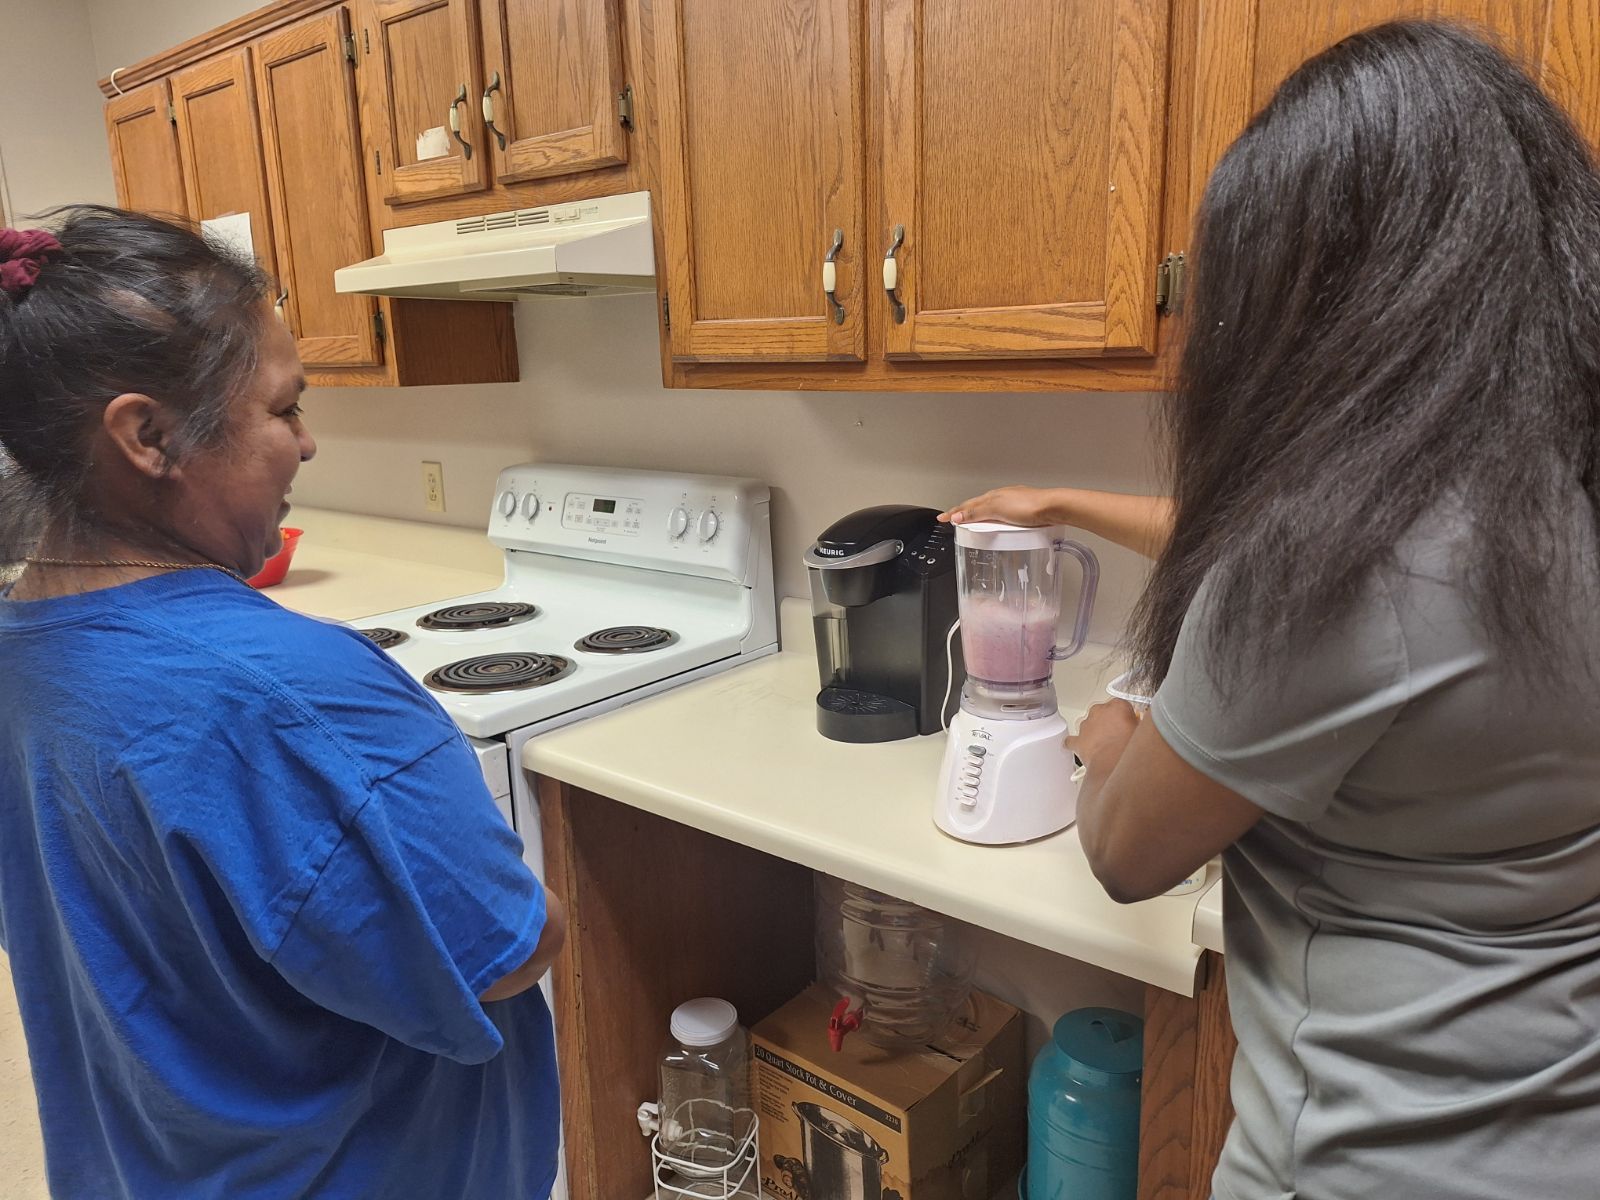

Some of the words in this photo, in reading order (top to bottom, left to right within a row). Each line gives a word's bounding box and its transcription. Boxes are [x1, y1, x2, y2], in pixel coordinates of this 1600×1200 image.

[819, 547, 845, 556] KEURIG
[971, 731, 990, 741] RIVAL
[756, 1046, 765, 1058] 20
[766, 1051, 784, 1069] Quart
[785, 1061, 805, 1080] Stock
[805, 1072, 818, 1087] Pot
[819, 1080, 827, 1091] &
[829, 1084, 857, 1106] Cover
